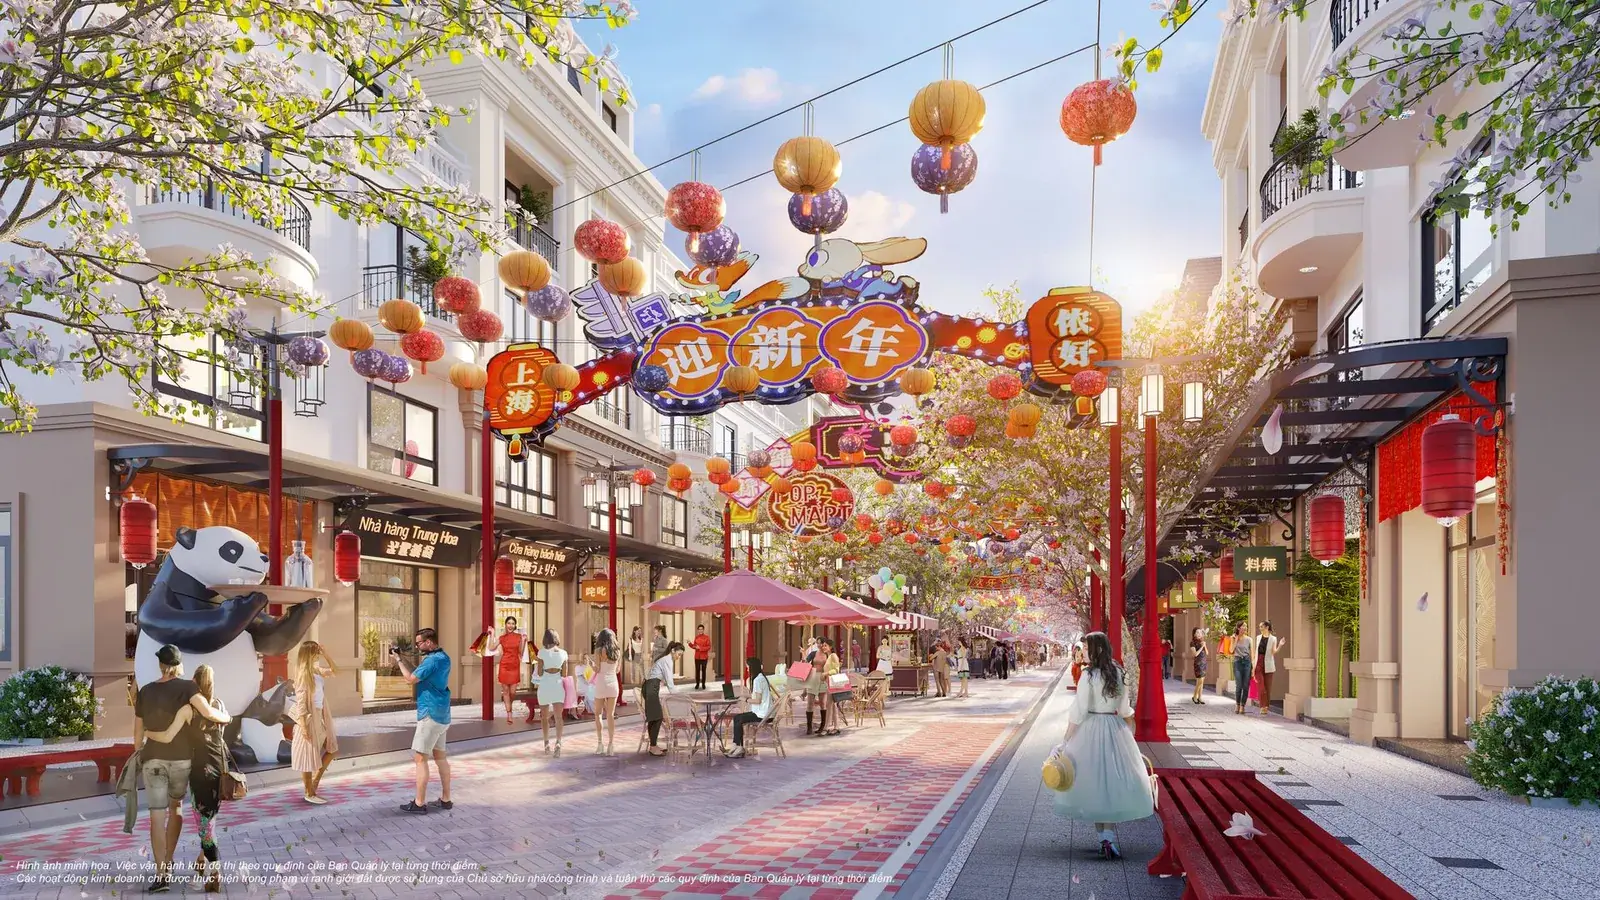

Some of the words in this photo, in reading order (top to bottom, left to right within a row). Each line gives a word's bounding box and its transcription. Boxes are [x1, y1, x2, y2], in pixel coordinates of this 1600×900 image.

[657, 317, 905, 386] 迎新年
[505, 362, 537, 416] 上海
[774, 484, 818, 504] OP
[789, 502, 853, 527] MART
[359, 516, 382, 533] Nhà
[383, 520, 410, 540] hàng
[412, 525, 439, 546] Trung
[440, 530, 459, 546] Hoa
[509, 542, 523, 555] Cửa
[523, 545, 540, 560] hàng
[540, 548, 554, 560] bách
[554, 550, 566, 563] hóa
